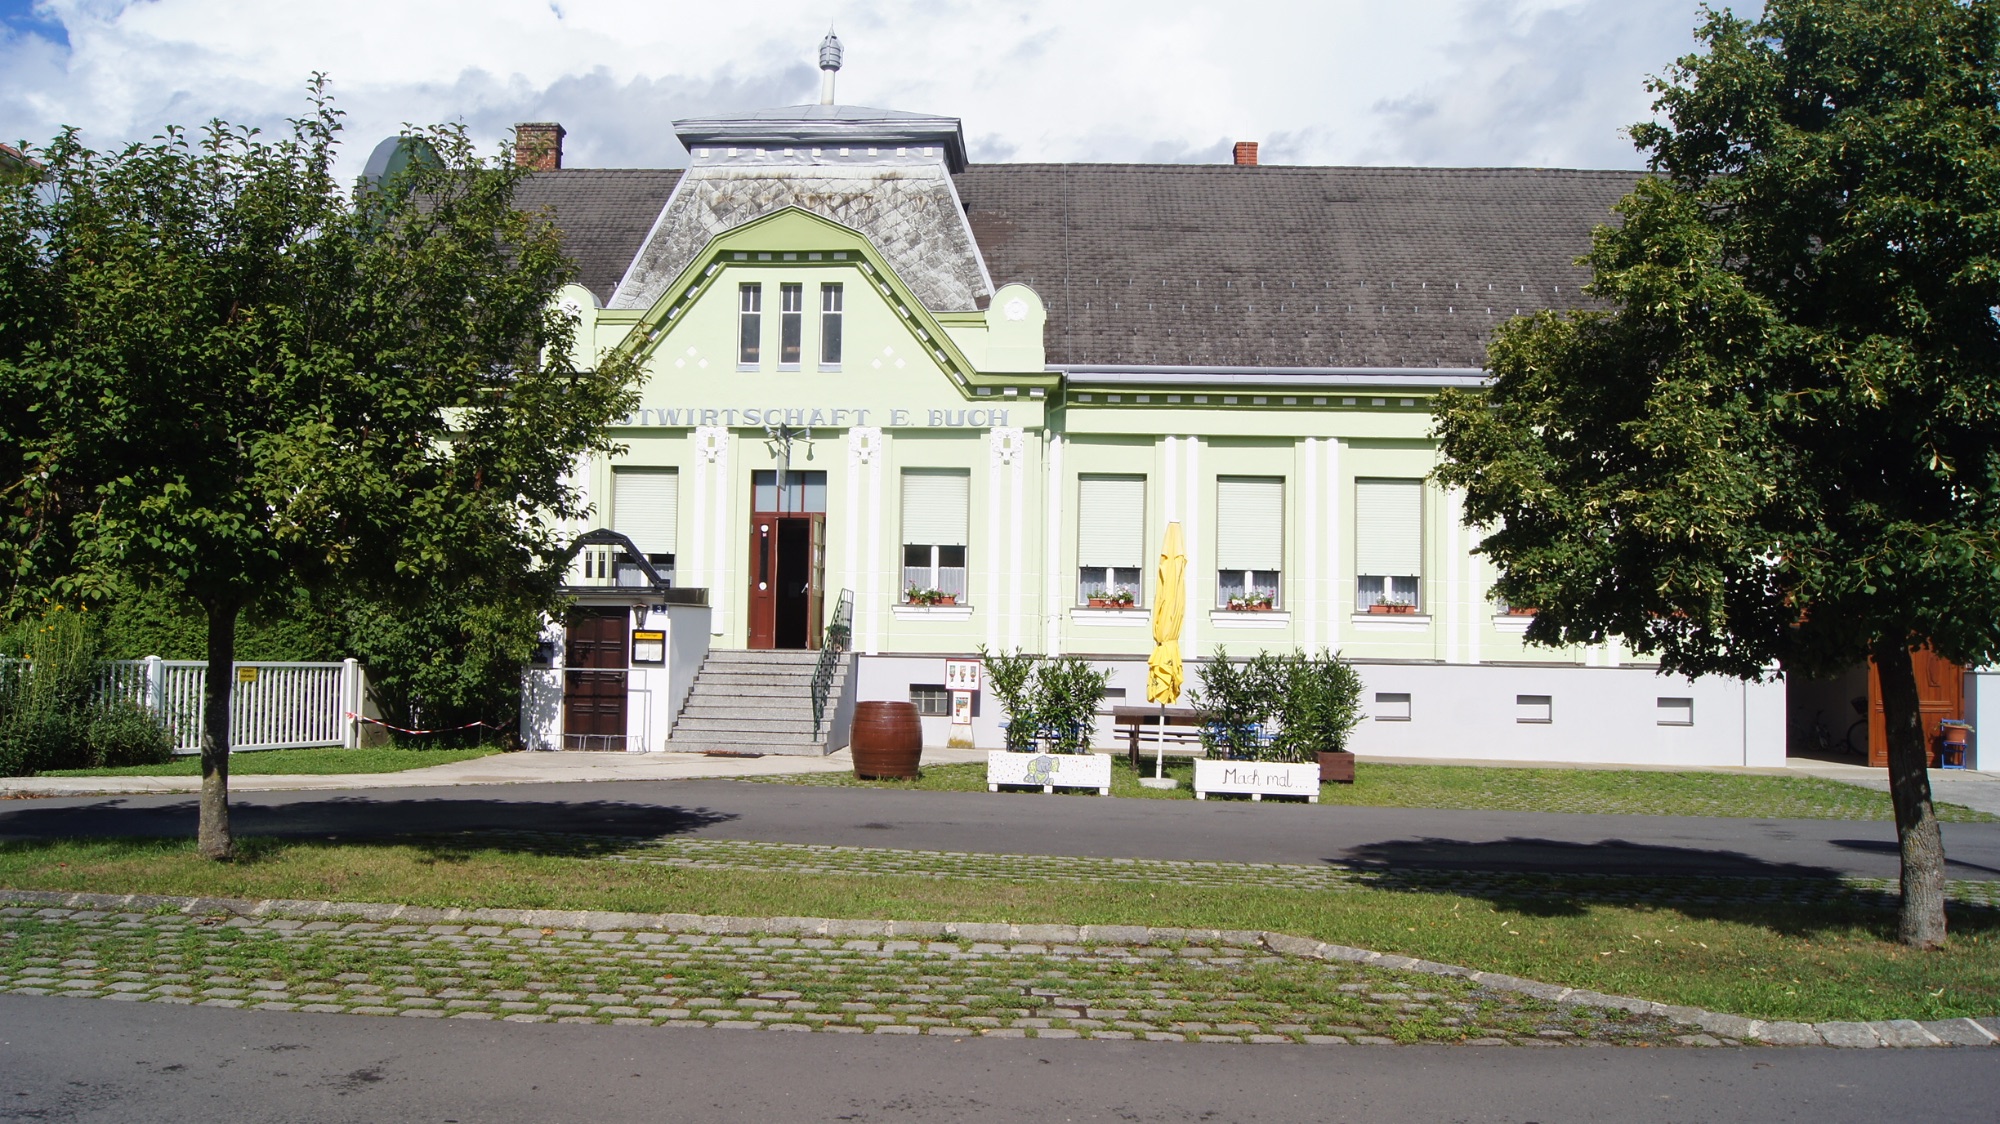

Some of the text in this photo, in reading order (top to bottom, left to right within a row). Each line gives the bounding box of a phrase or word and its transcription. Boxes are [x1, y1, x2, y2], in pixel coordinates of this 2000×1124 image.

[606, 408, 1010, 427] STWIRTSCHAFT E. BUCH
[656, 605, 662, 613] 3
[1222, 768, 1261, 787] Mach
